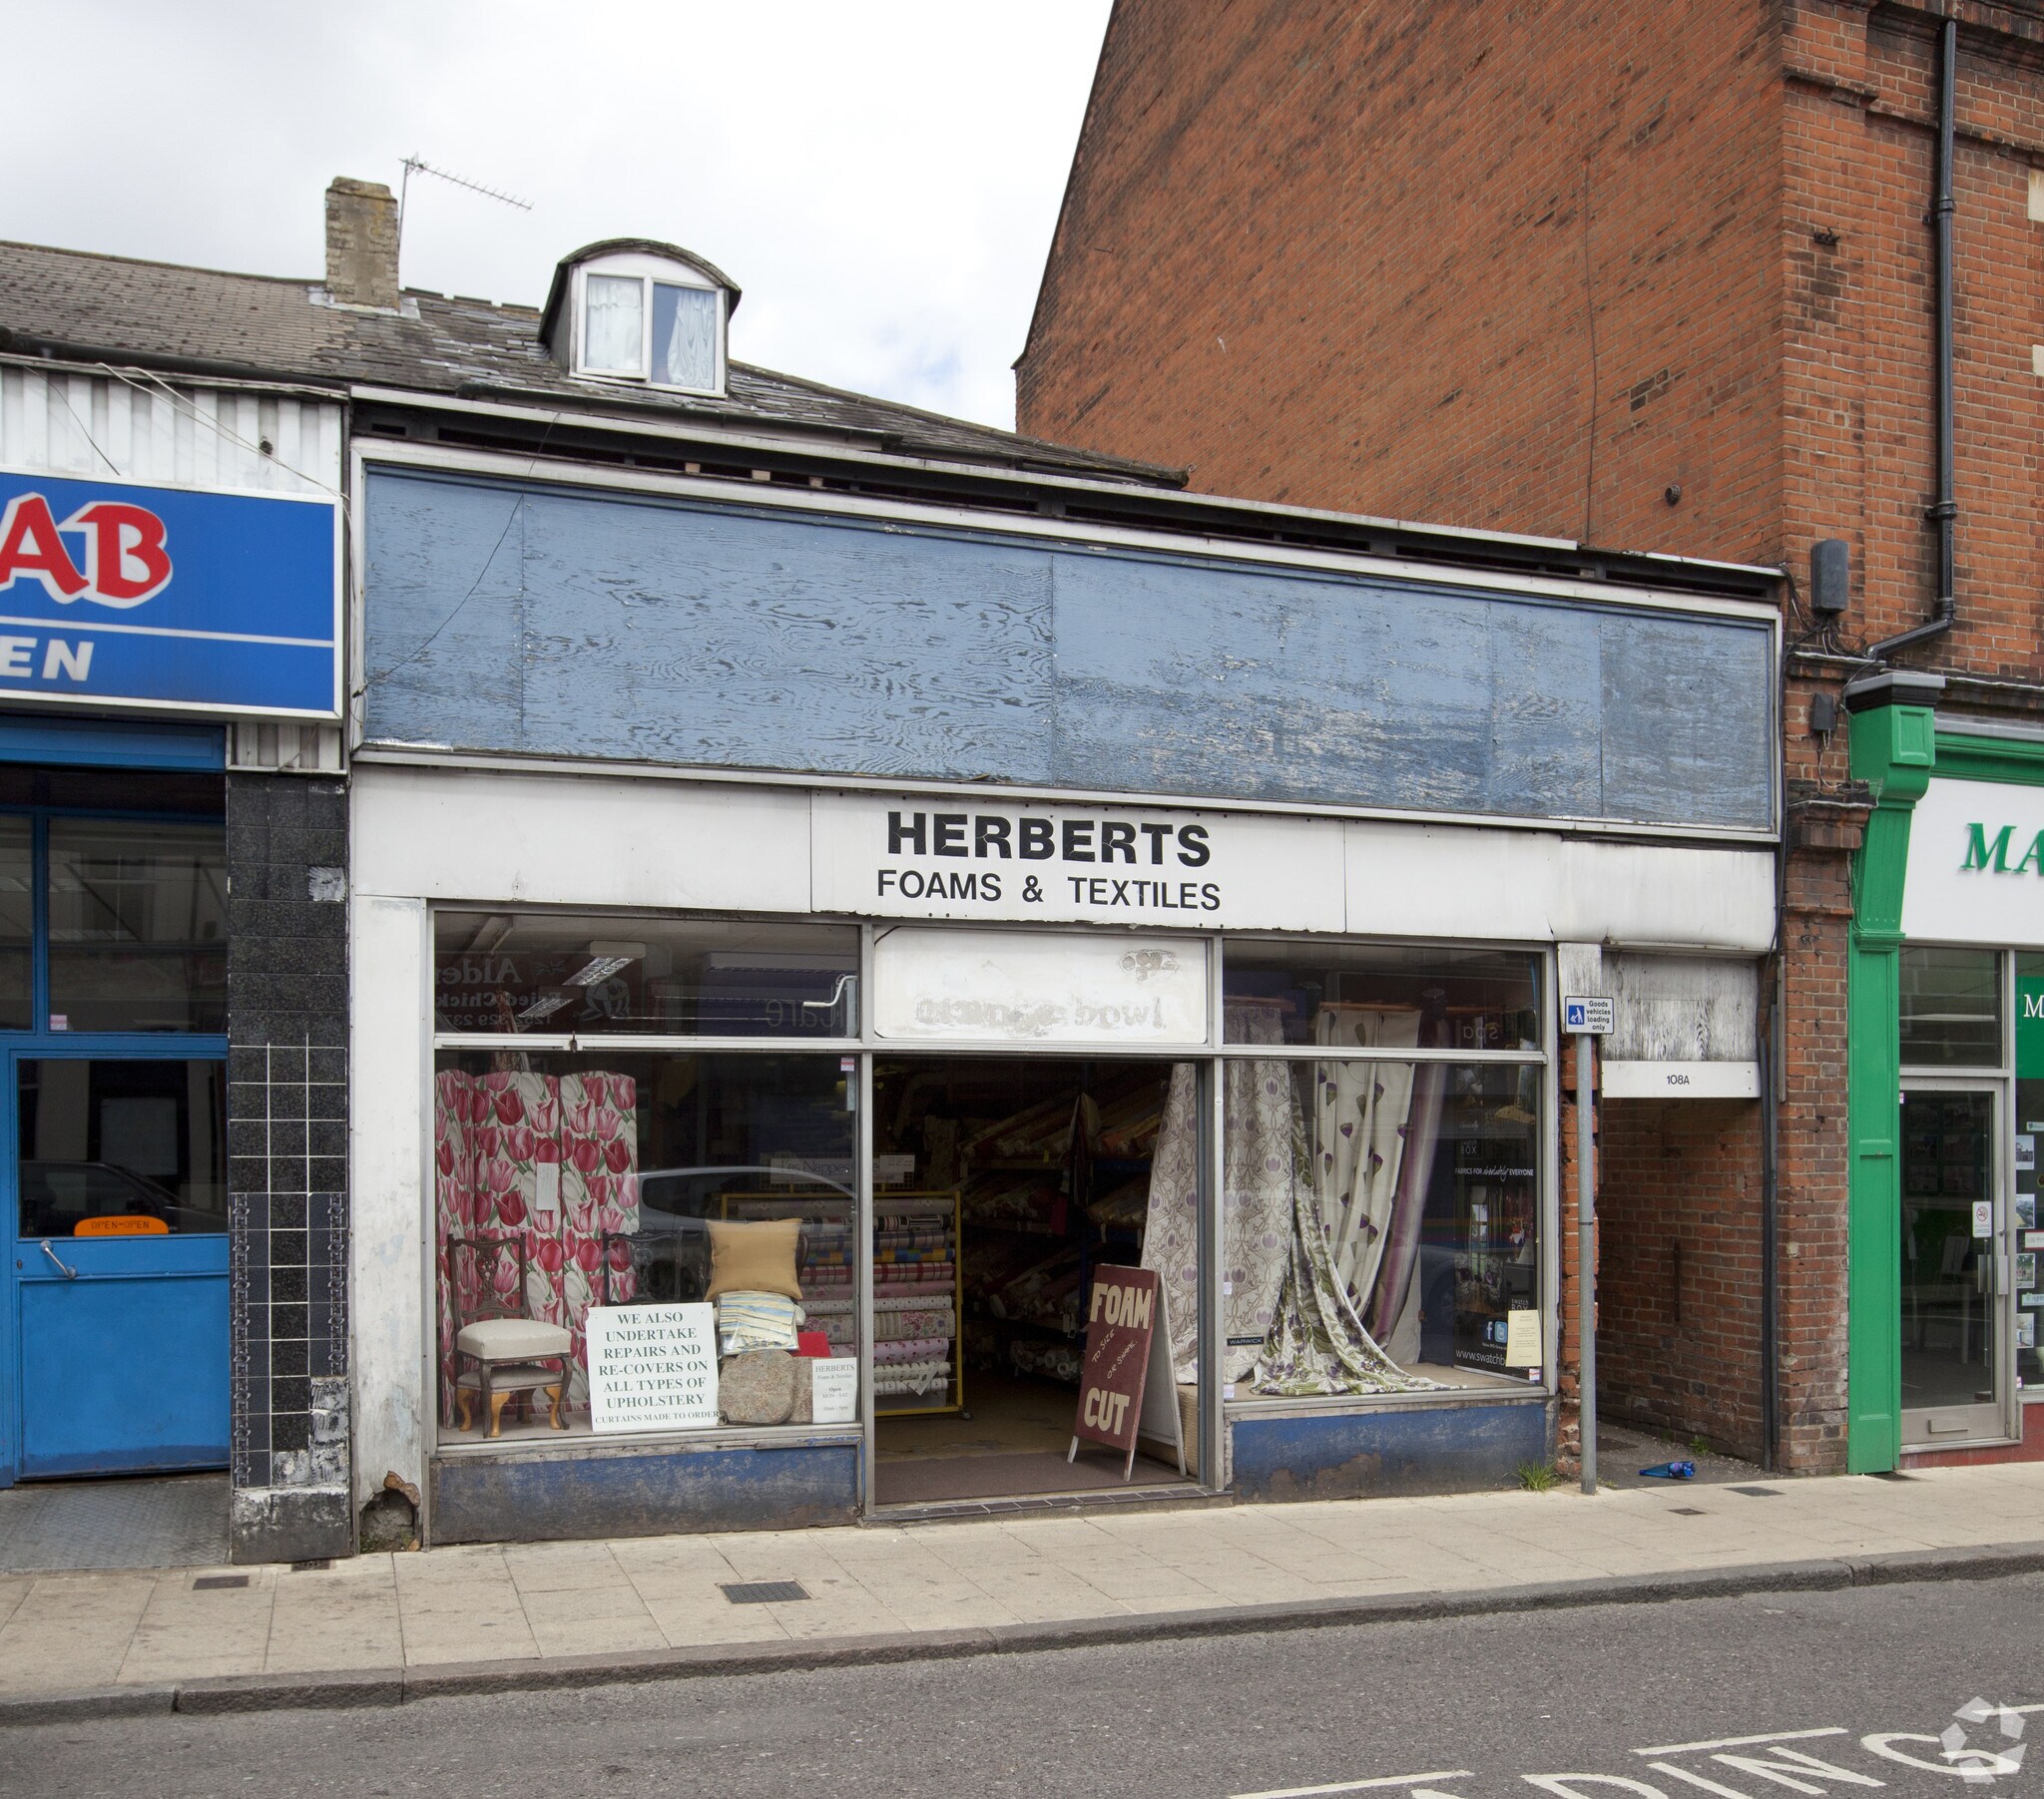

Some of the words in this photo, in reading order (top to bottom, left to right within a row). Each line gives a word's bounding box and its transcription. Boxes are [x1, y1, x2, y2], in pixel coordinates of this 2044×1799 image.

[887, 811, 1212, 867] HERBERTS
[877, 869, 1003, 902] FOAMS
[1021, 875, 1045, 903] &
[1067, 876, 1222, 911] TEXTILES
[1667, 1075, 1690, 1085] 108A
[1090, 1282, 1152, 1330] FOAM
[617, 1313, 642, 1325] WE
[645, 1311, 684, 1324] ALSO
[606, 1327, 698, 1342] UNDERTAKE
[604, 1346, 667, 1359] REPAIRS
[671, 1344, 702, 1357] AND
[1091, 1351, 1101, 1363] TO
[1100, 1328, 1115, 1350] SIZE
[599, 1361, 684, 1376] RE-COVERS
[687, 1360, 709, 1372] ON
[815, 1364, 855, 1373] HERBERTS
[1107, 1366, 1117, 1380] OR
[603, 1381, 633, 1393] ALL
[637, 1378, 684, 1391] TYPES
[687, 1377, 707, 1388] OF
[607, 1394, 706, 1409] UPHOLSTERY
[595, 1415, 643, 1424] CURTAINS
[644, 1413, 672, 1422] MADE
[688, 1410, 720, 1419] ORDER
[1084, 1387, 1130, 1435] CUT
